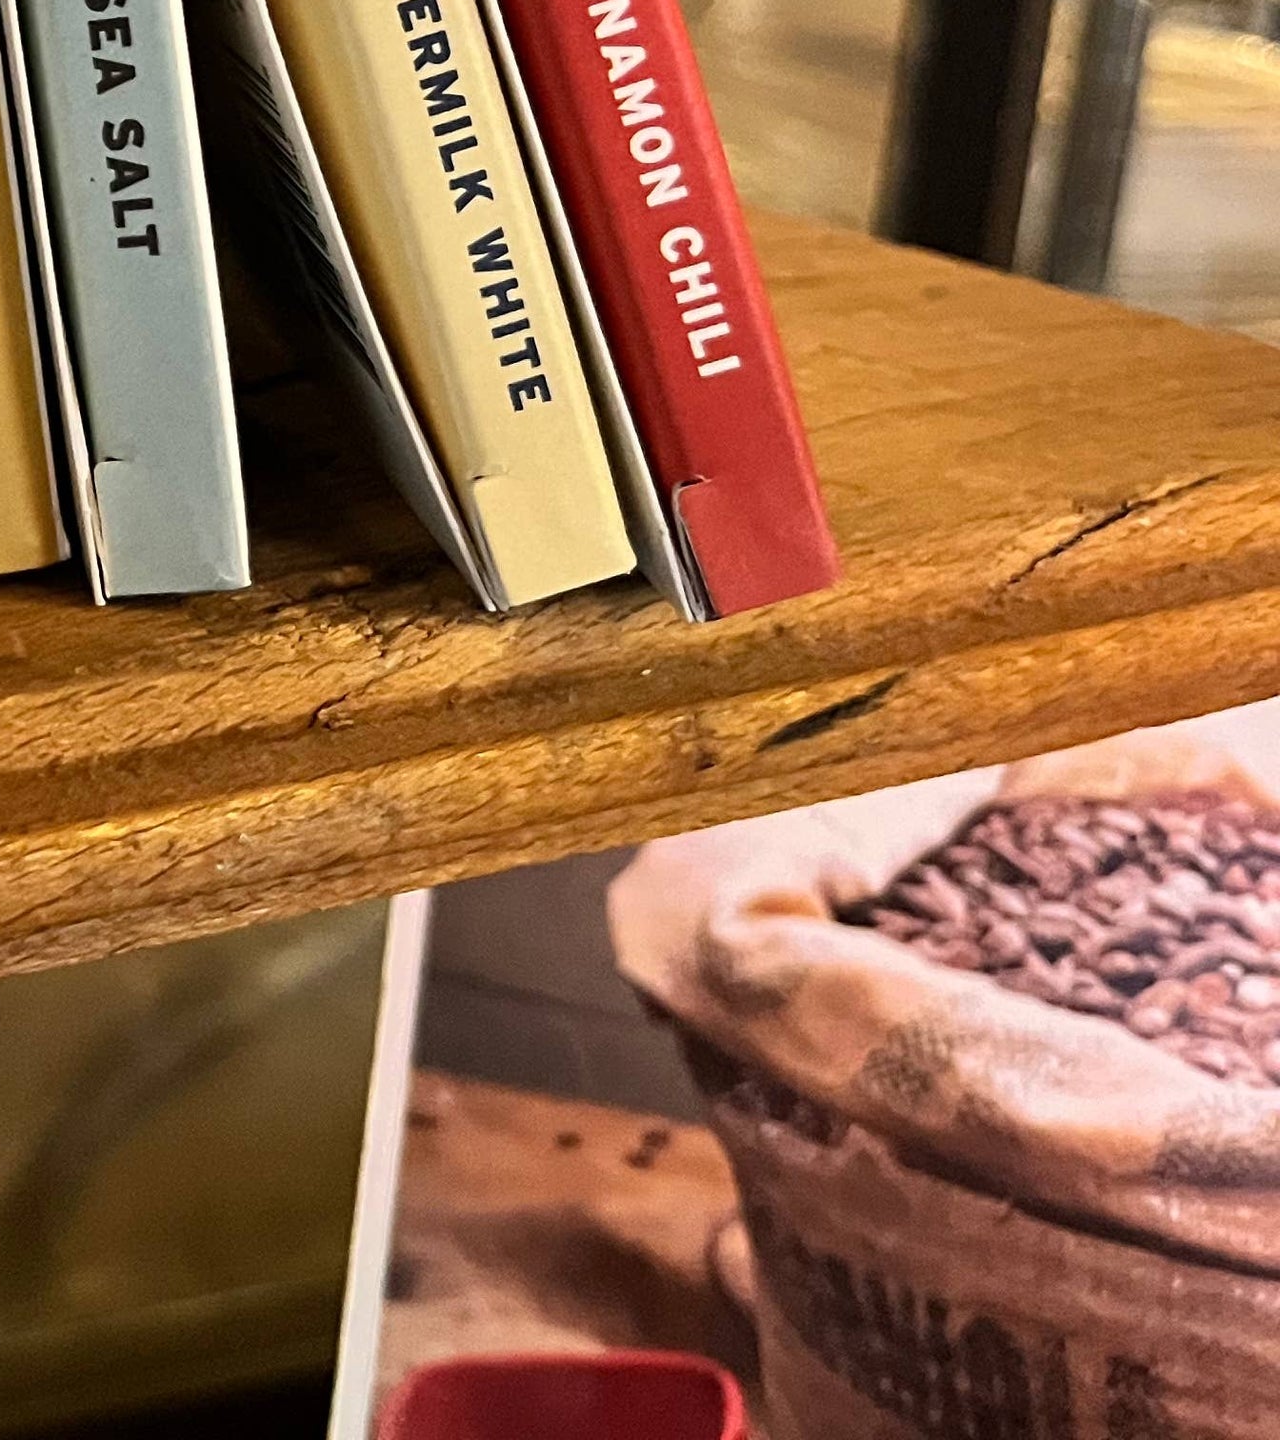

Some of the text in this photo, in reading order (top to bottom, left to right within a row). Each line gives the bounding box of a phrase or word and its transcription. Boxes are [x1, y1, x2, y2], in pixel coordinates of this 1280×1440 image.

[101, 118, 160, 256] SALT
[467, 226, 552, 413] WHITE
[659, 225, 741, 378] CHILI
